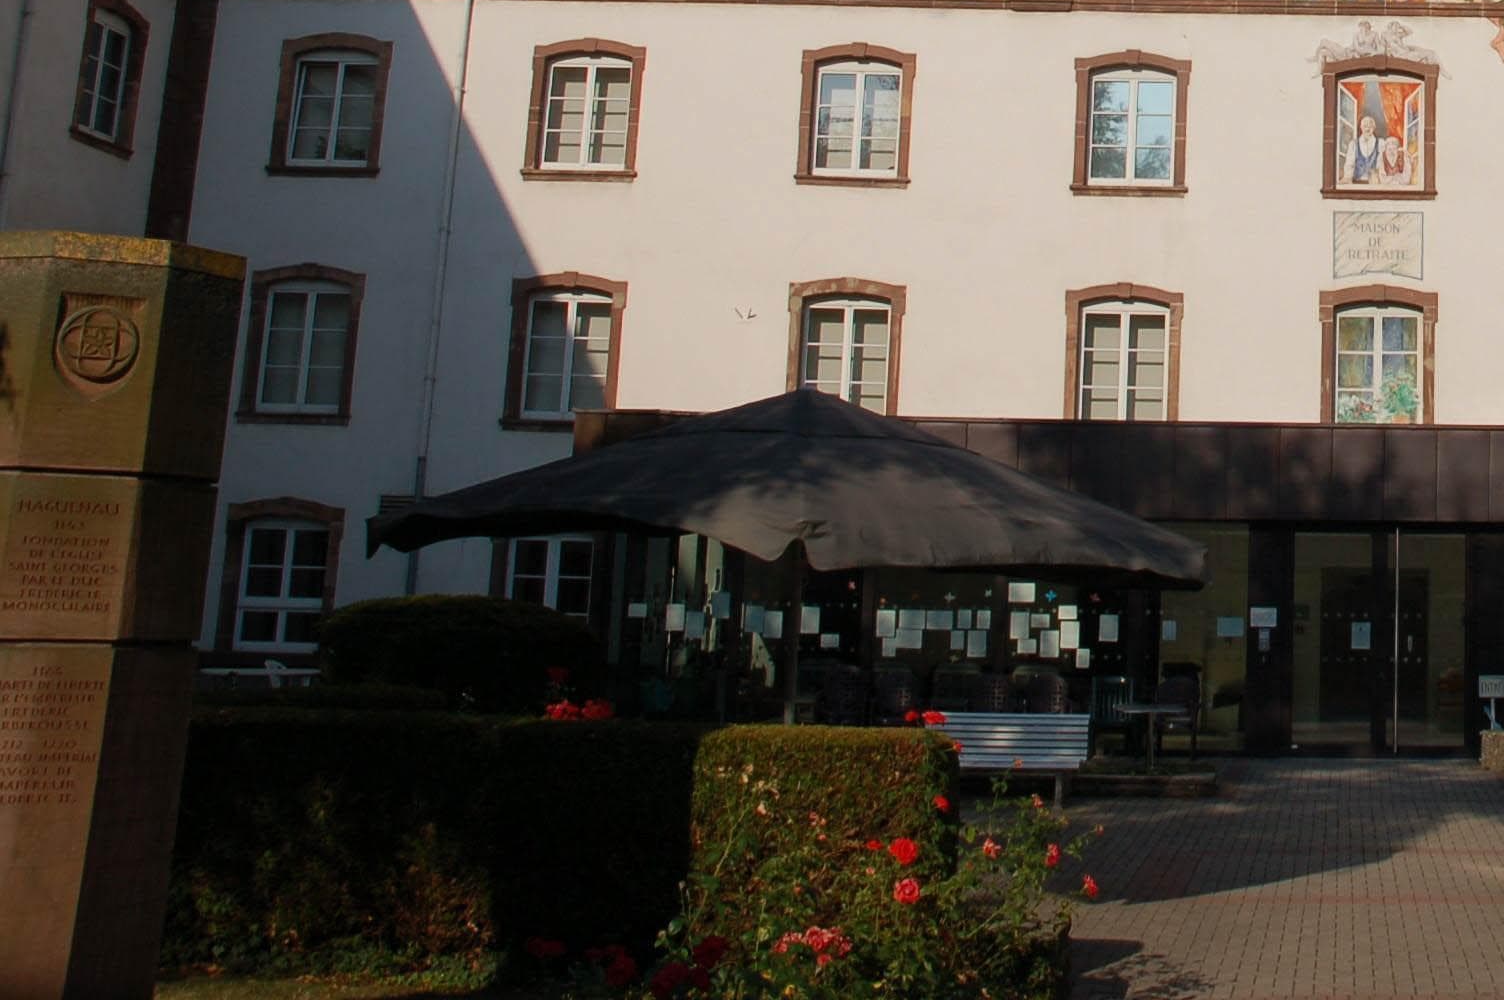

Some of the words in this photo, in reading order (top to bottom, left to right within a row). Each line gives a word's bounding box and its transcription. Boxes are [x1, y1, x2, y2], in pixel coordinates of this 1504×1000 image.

[1352, 223, 1400, 233] MAISON
[1368, 237, 1383, 248] DE
[1347, 249, 1408, 260] RETRAITE
[18, 499, 120, 515] HAGUENAU
